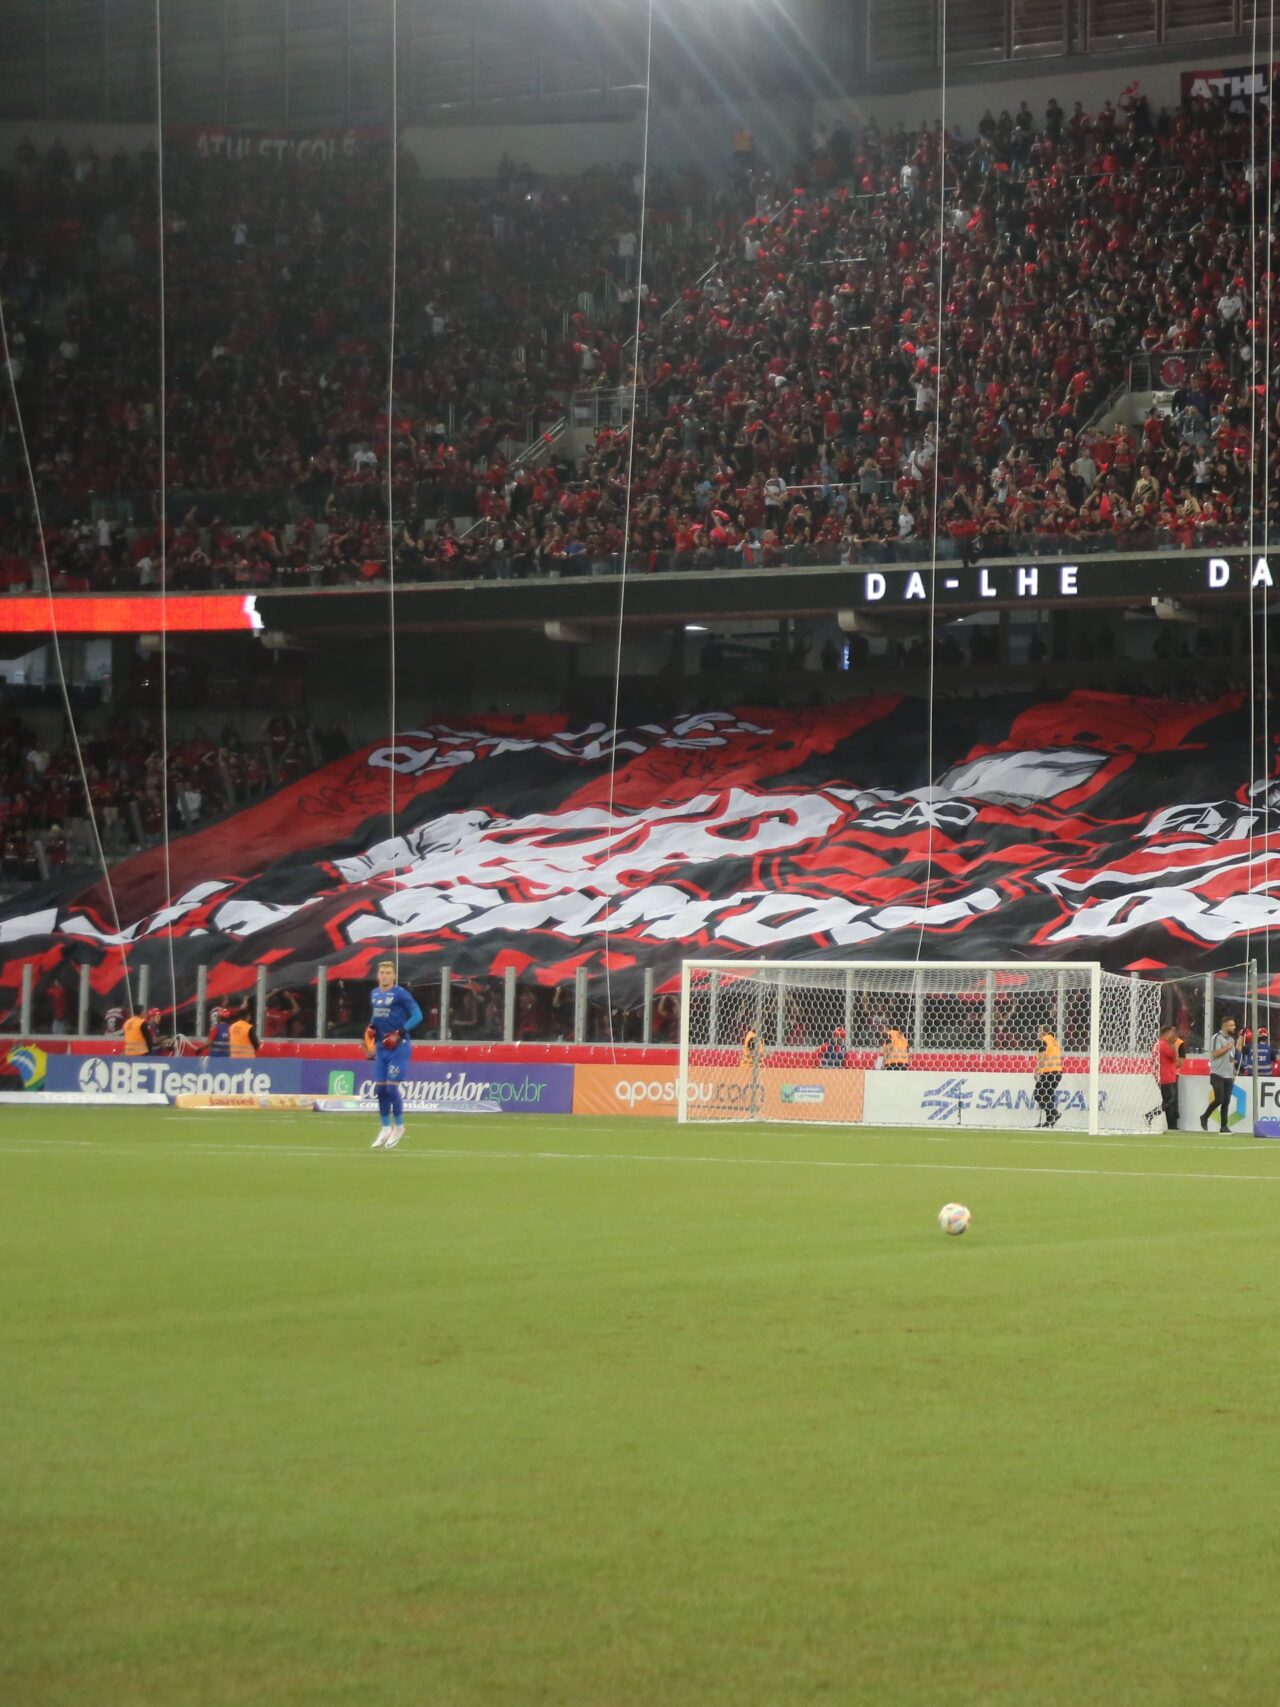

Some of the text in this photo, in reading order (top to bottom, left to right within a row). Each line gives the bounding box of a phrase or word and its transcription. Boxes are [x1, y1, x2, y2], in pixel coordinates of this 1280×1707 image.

[867, 565, 1078, 600] DA-LHE
[359, 1072, 547, 1104] cosumidor.gov.br
[615, 1077, 765, 1108] aposou.com
[976, 1088, 1108, 1112] SANPAR
